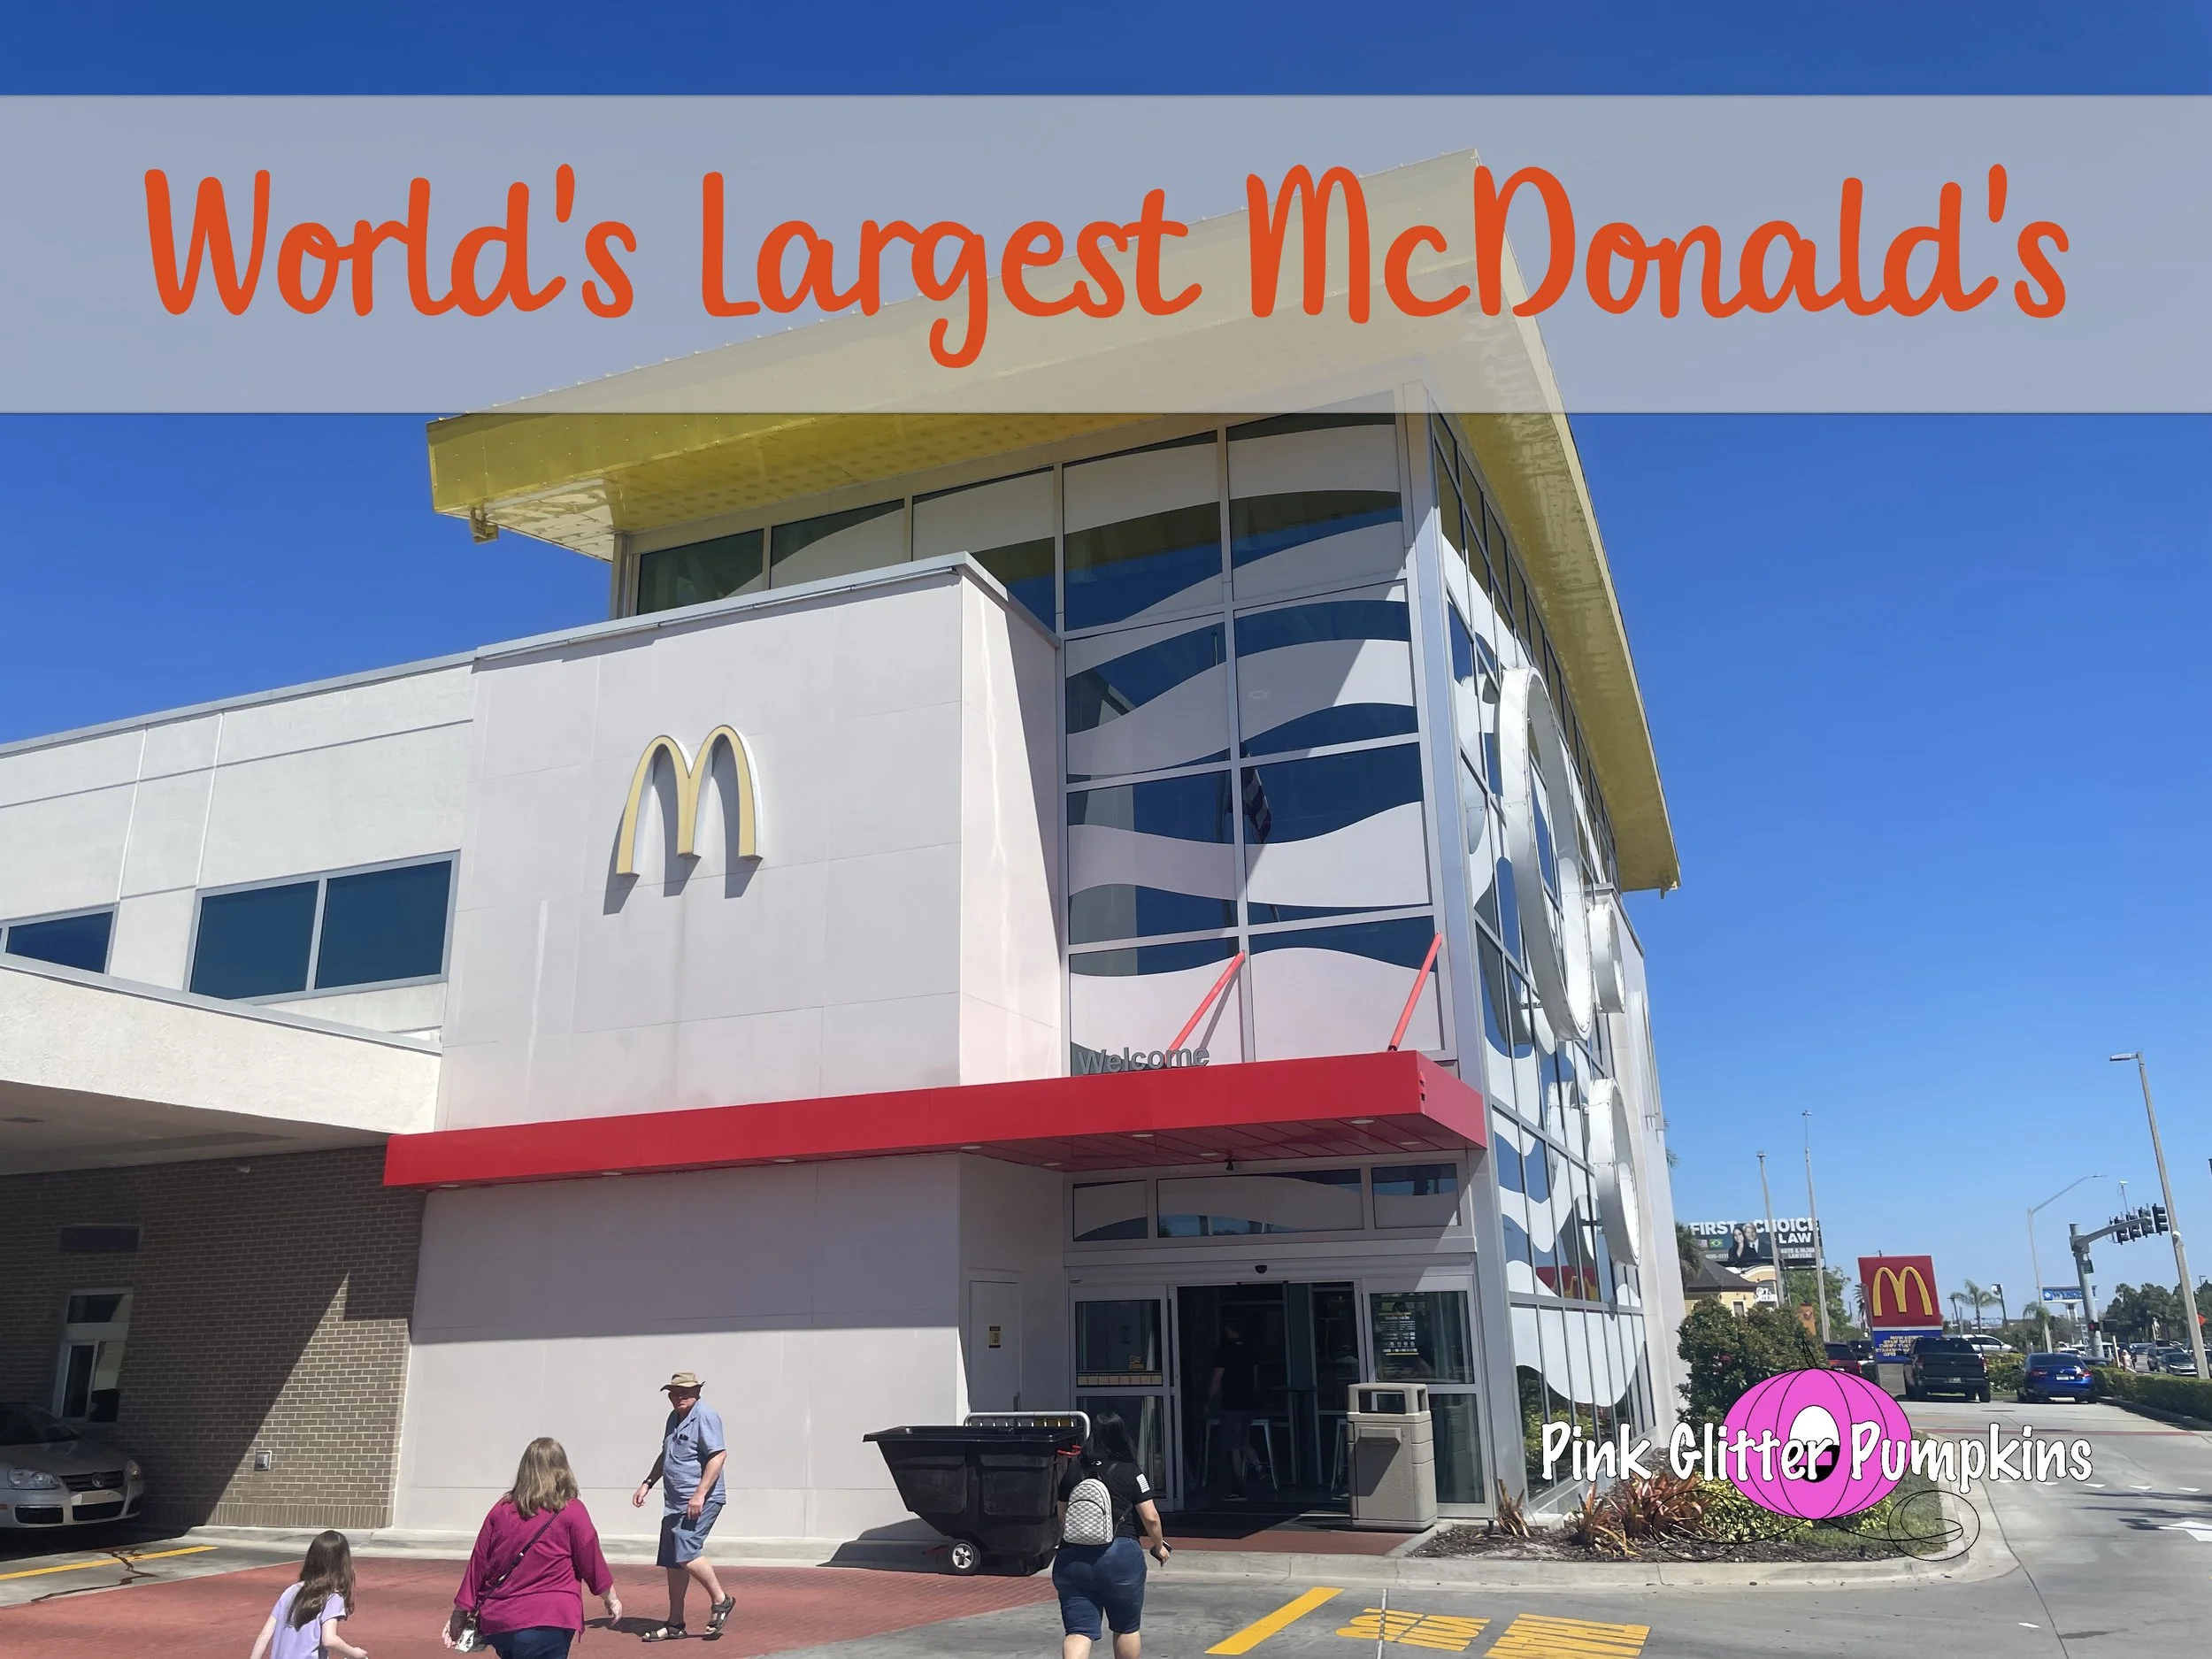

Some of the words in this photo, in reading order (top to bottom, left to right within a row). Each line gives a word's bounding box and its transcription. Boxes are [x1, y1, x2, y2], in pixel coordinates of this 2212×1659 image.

[1078, 1046, 1210, 1075] Welcome
[1689, 1220, 1737, 1236] FIRST
[1778, 1233, 1812, 1244] LAW
